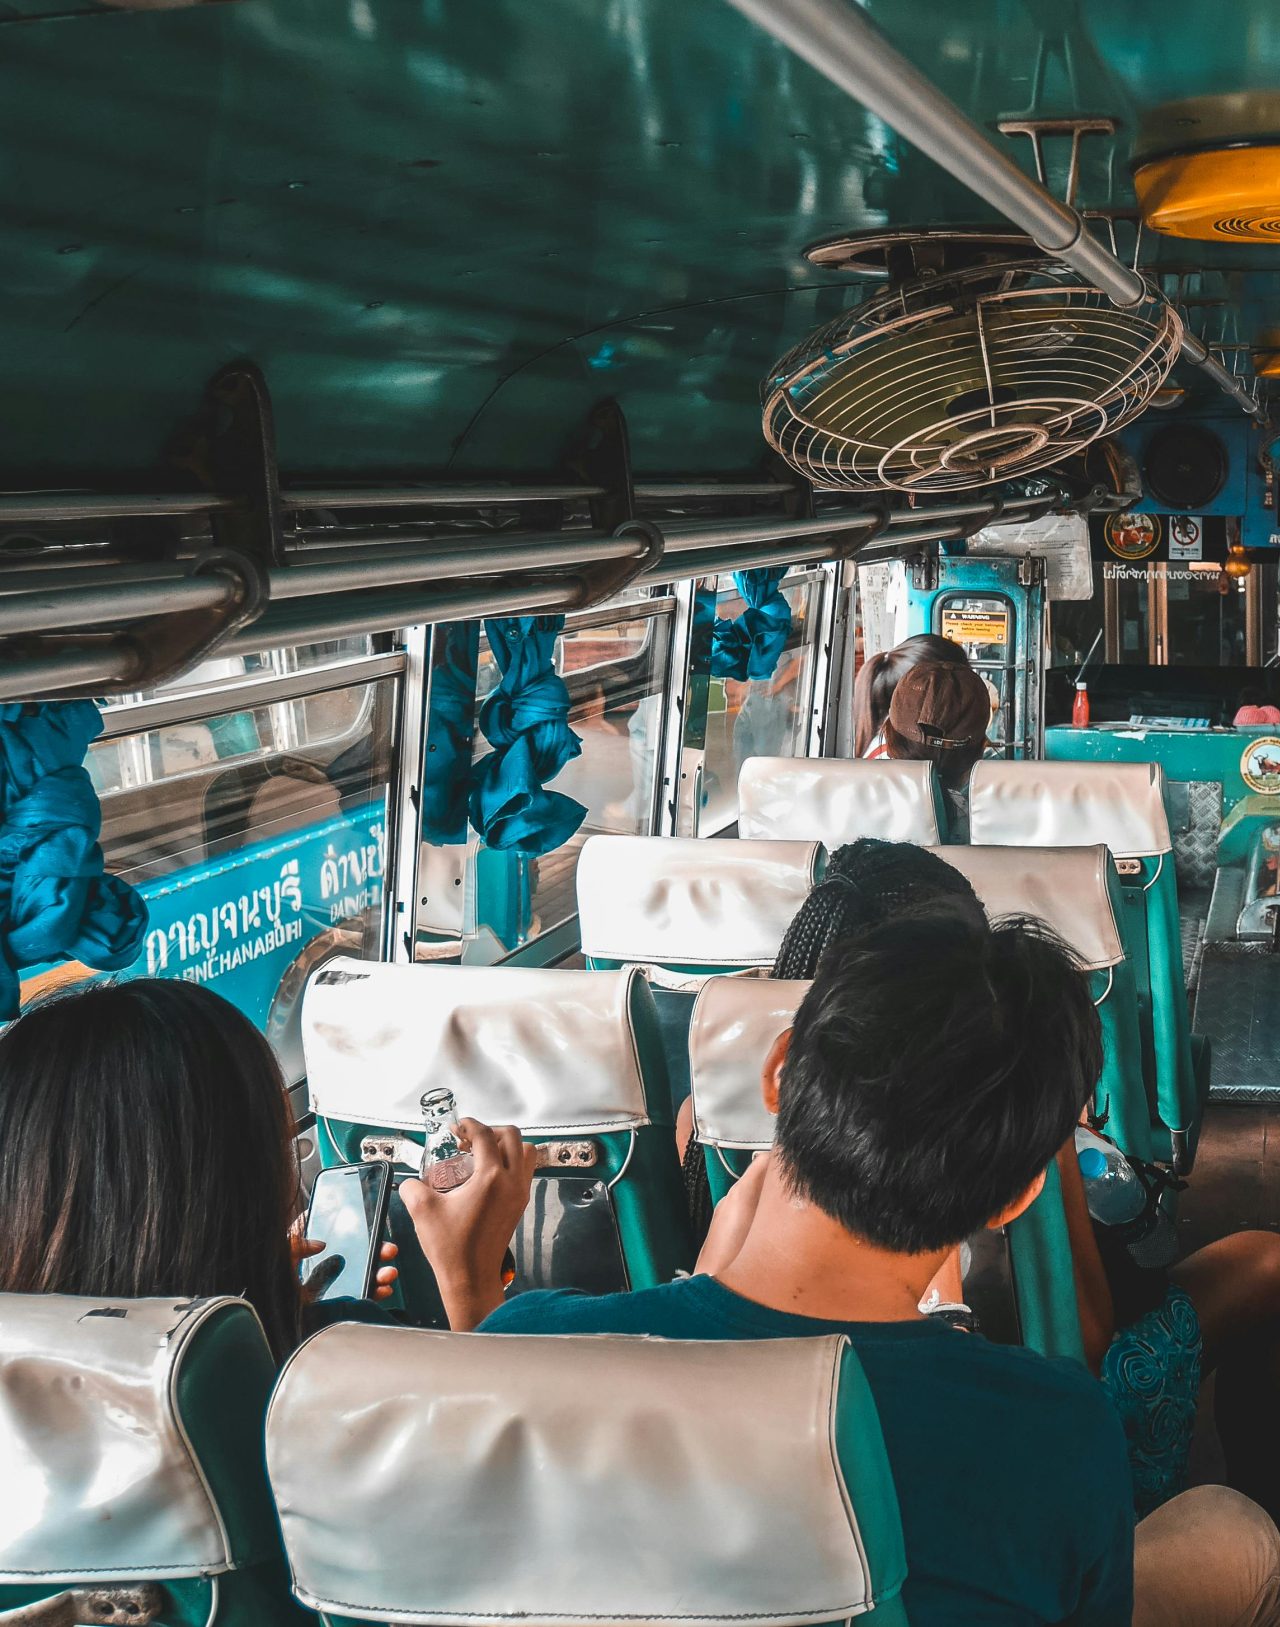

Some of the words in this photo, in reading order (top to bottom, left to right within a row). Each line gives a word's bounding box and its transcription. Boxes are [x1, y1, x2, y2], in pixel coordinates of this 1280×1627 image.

[961, 613, 991, 621] WARNING
[145, 858, 302, 977] กาญจนบุรี
[320, 822, 385, 899] ด่านช้
